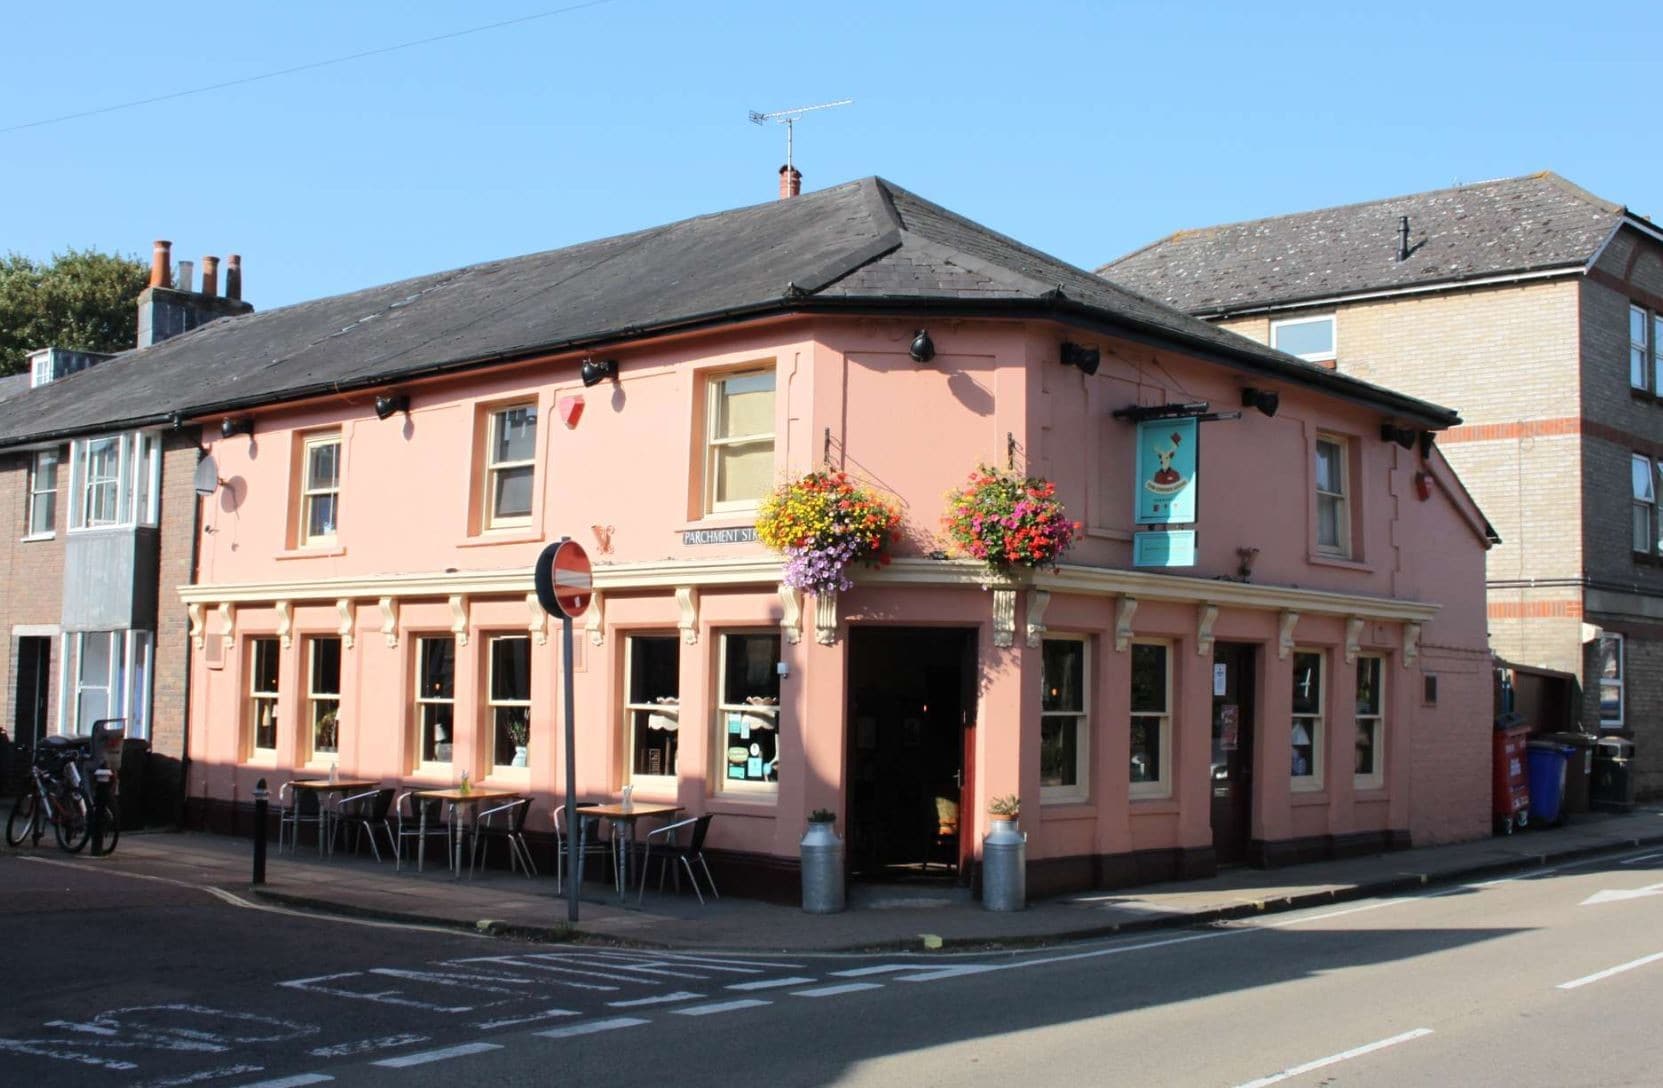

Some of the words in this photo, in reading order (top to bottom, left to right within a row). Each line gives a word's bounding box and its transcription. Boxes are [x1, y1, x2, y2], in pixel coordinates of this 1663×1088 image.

[685, 529, 737, 545] PARCHMENT
[0, 1004, 321, 1069] NO
[276, 951, 805, 1013] ENTRY
